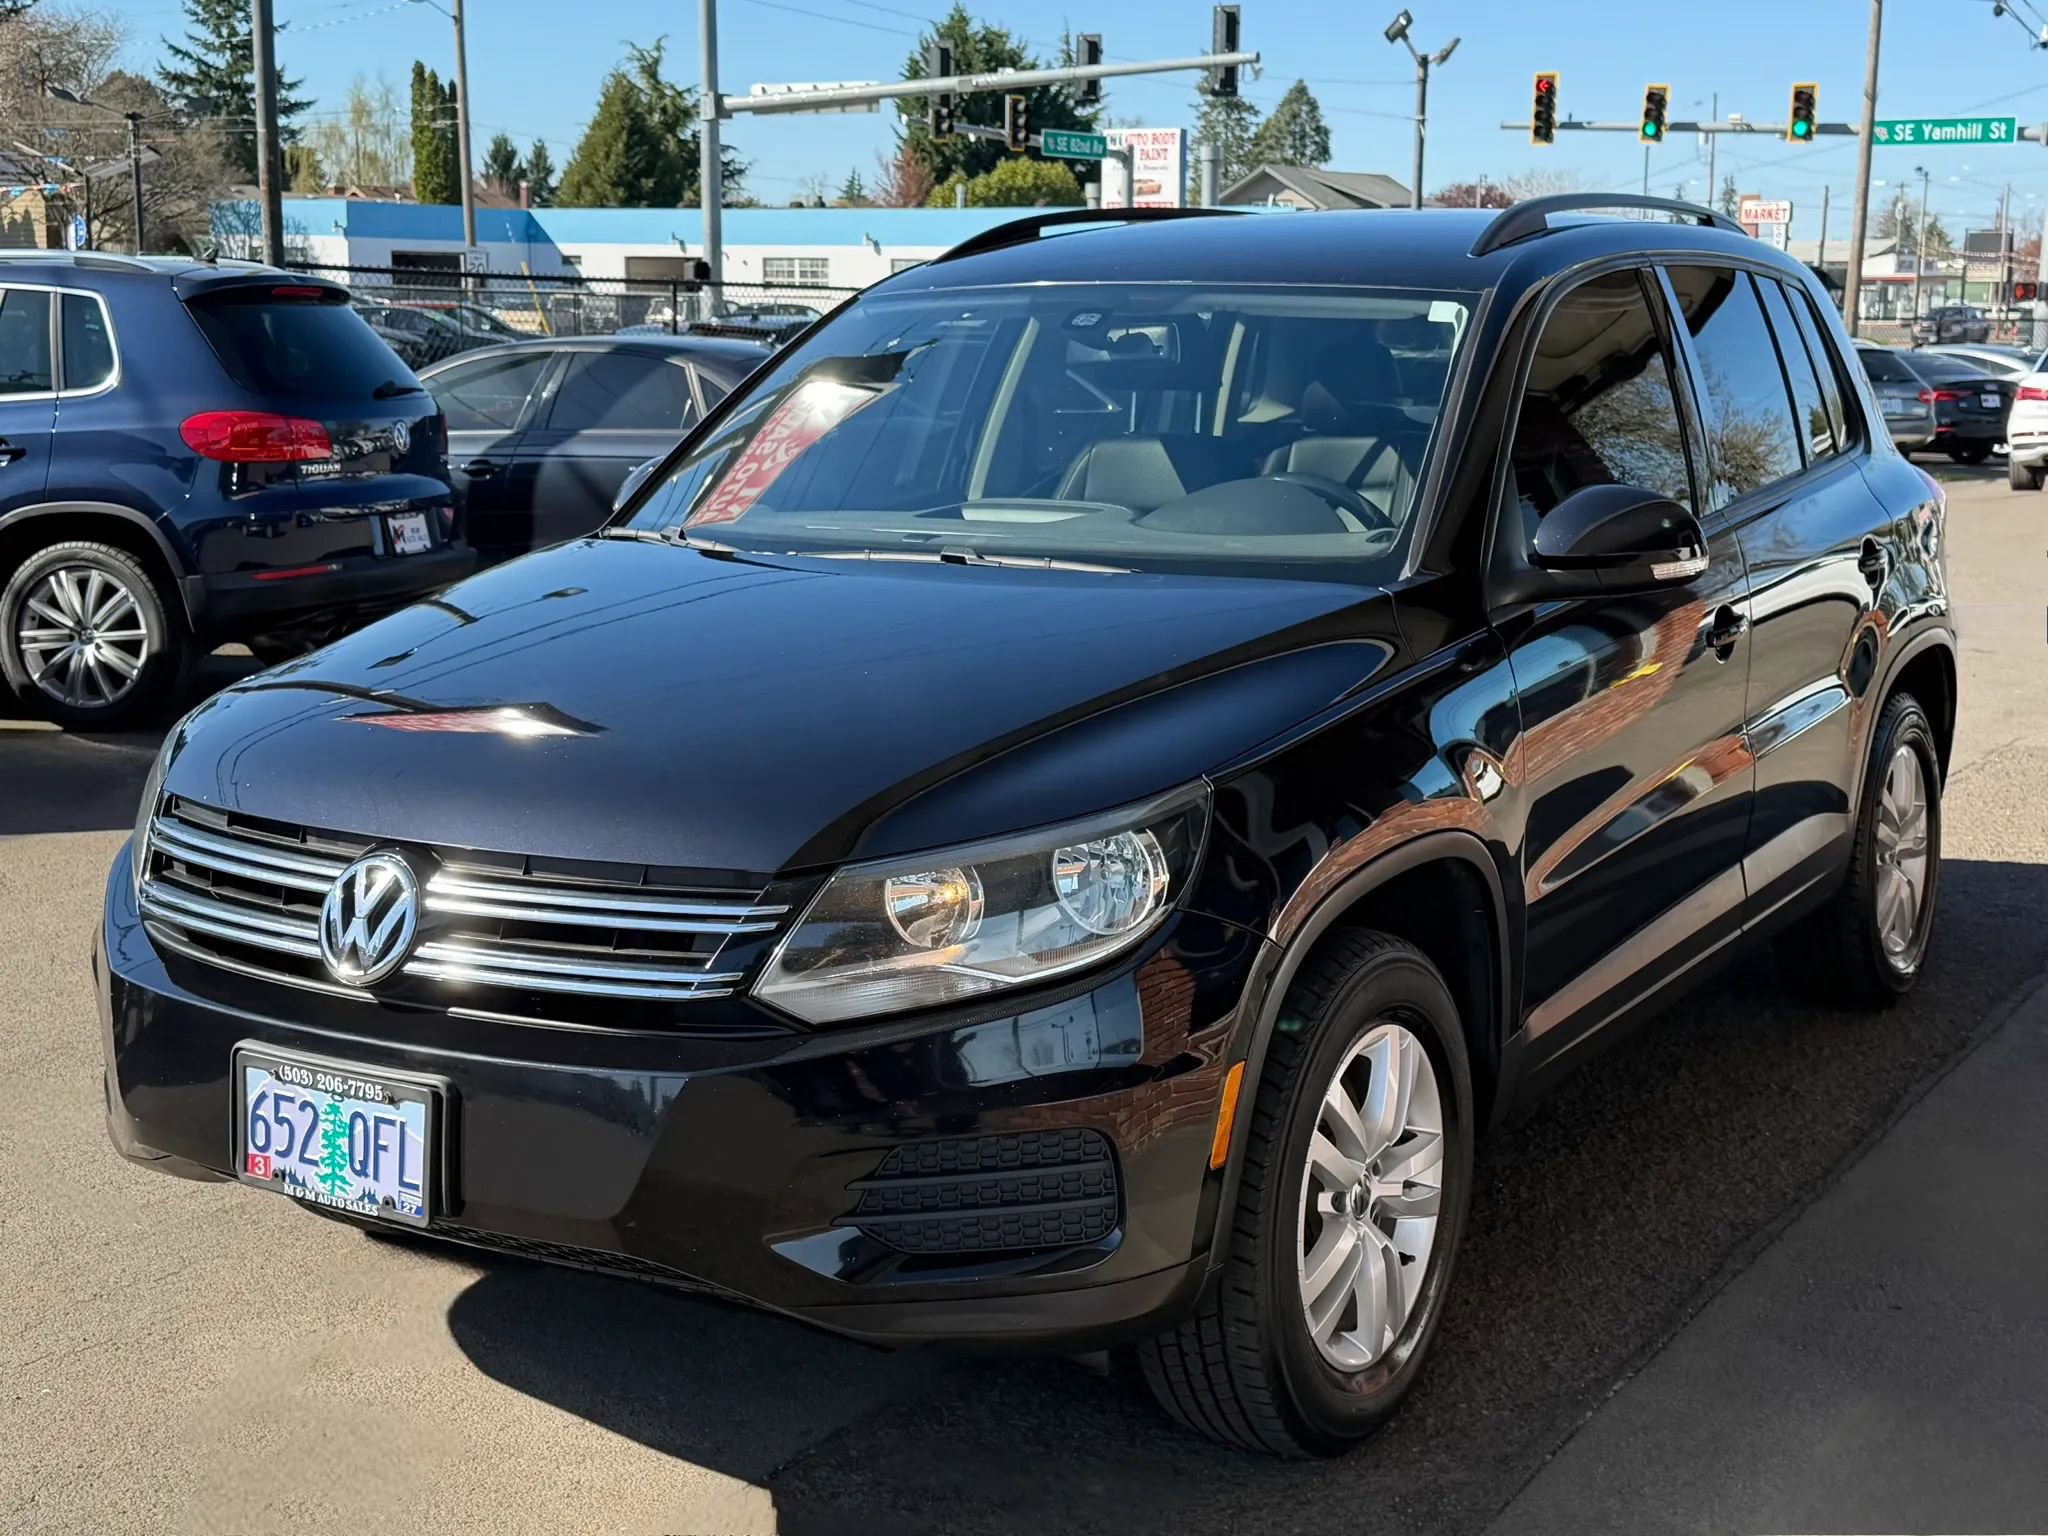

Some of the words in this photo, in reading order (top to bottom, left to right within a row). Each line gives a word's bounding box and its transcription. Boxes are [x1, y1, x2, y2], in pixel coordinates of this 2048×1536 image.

[1151, 132, 1177, 145] BODY
[1894, 123, 1915, 141] SE
[1922, 122, 1982, 141] Yamhill
[1989, 121, 2007, 140] St
[1056, 136, 1068, 151] SE
[1139, 148, 1169, 161] PAINT
[1744, 207, 1788, 221] MARKET
[300, 462, 342, 475] TIGUAN
[279, 1065, 313, 1087] (503)
[317, 1073, 383, 1101] 206-7795
[250, 1089, 320, 1167] 652
[348, 1110, 420, 1192] QFL
[254, 1158, 265, 1175] 3
[283, 1183, 294, 1196] M
[296, 1187, 304, 1198] &
[305, 1190, 316, 1202] M
[317, 1192, 344, 1209] AUTO
[346, 1199, 379, 1217] SALES
[403, 1200, 417, 1214] 27
